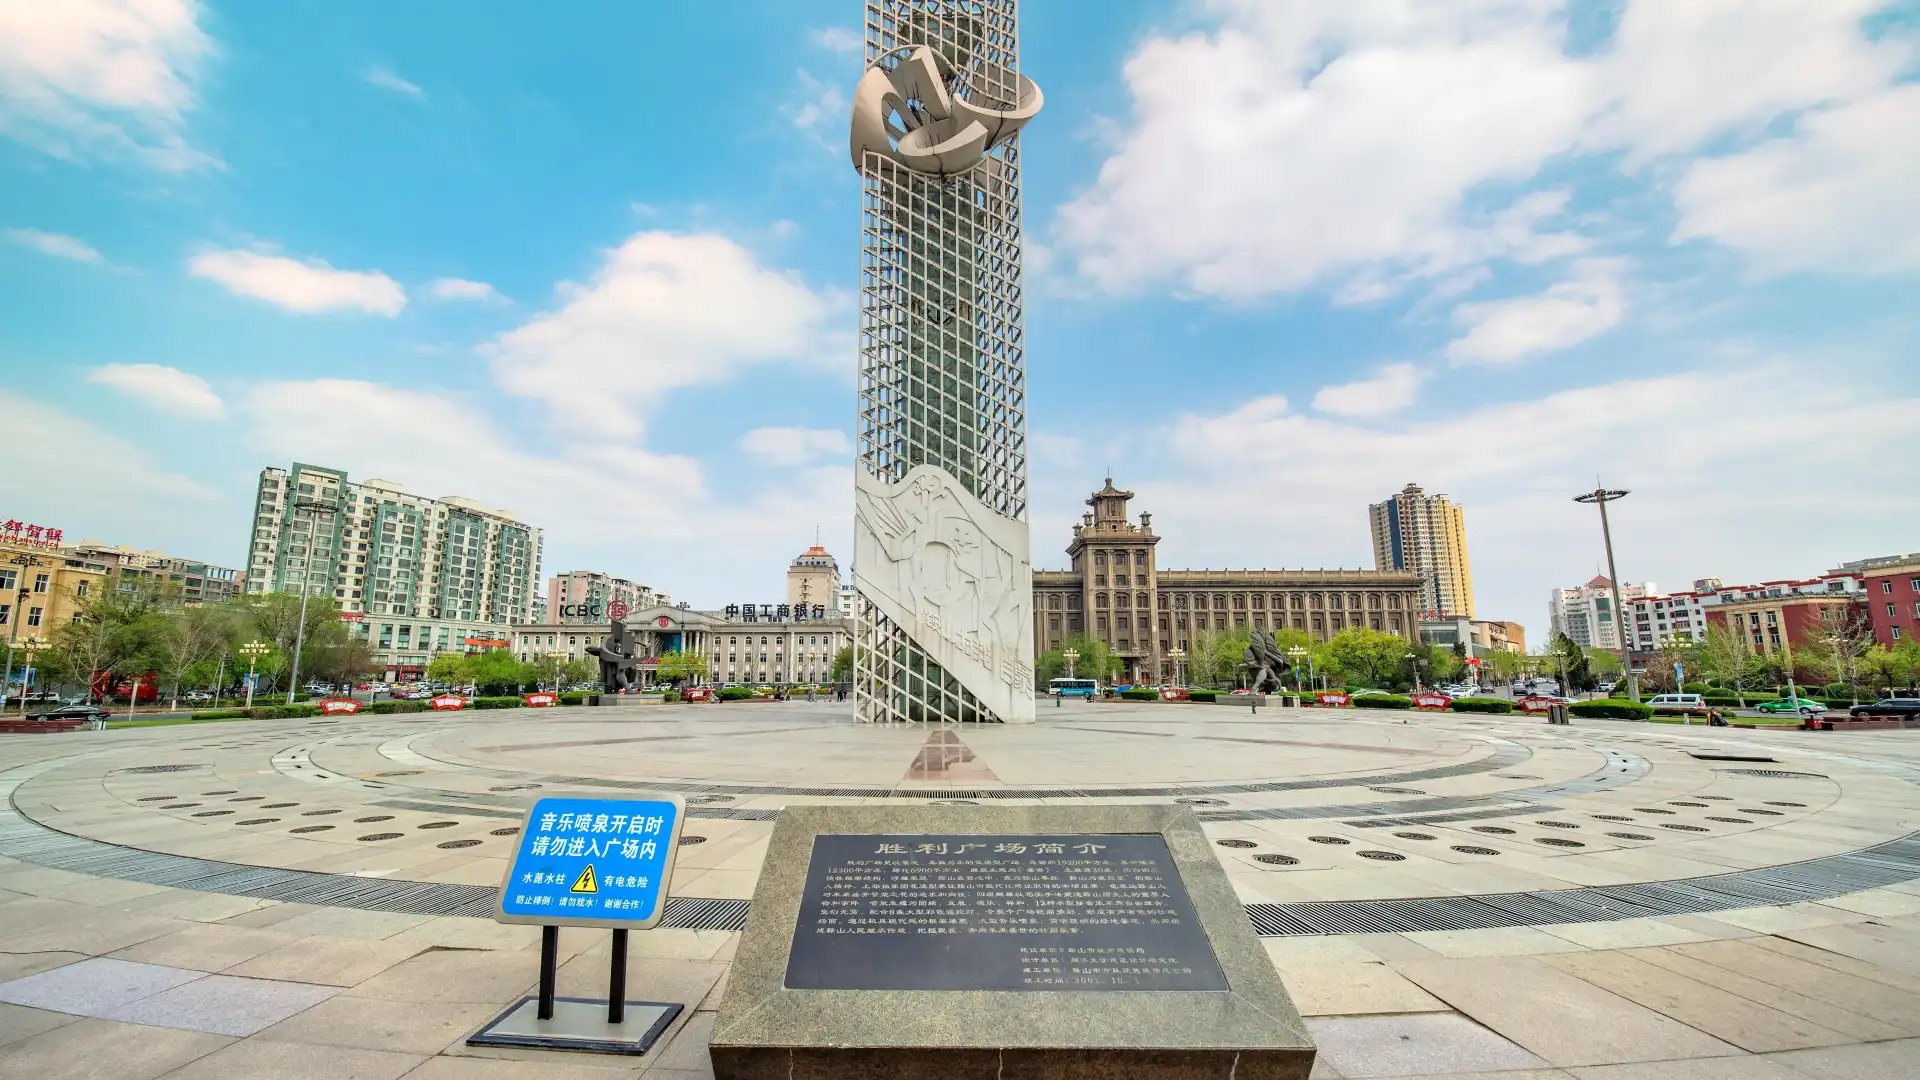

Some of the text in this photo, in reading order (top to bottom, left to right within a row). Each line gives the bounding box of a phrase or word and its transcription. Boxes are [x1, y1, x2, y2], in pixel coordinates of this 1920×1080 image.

[559, 604, 601, 617] ICBC
[725, 603, 826, 619] 中国工商银行
[540, 812, 663, 835] 音乐喷泉开启时
[531, 836, 657, 860] 请勿进入广场内
[875, 842, 1107, 855] 胜利广场简介
[604, 875, 649, 888] 有电危险
